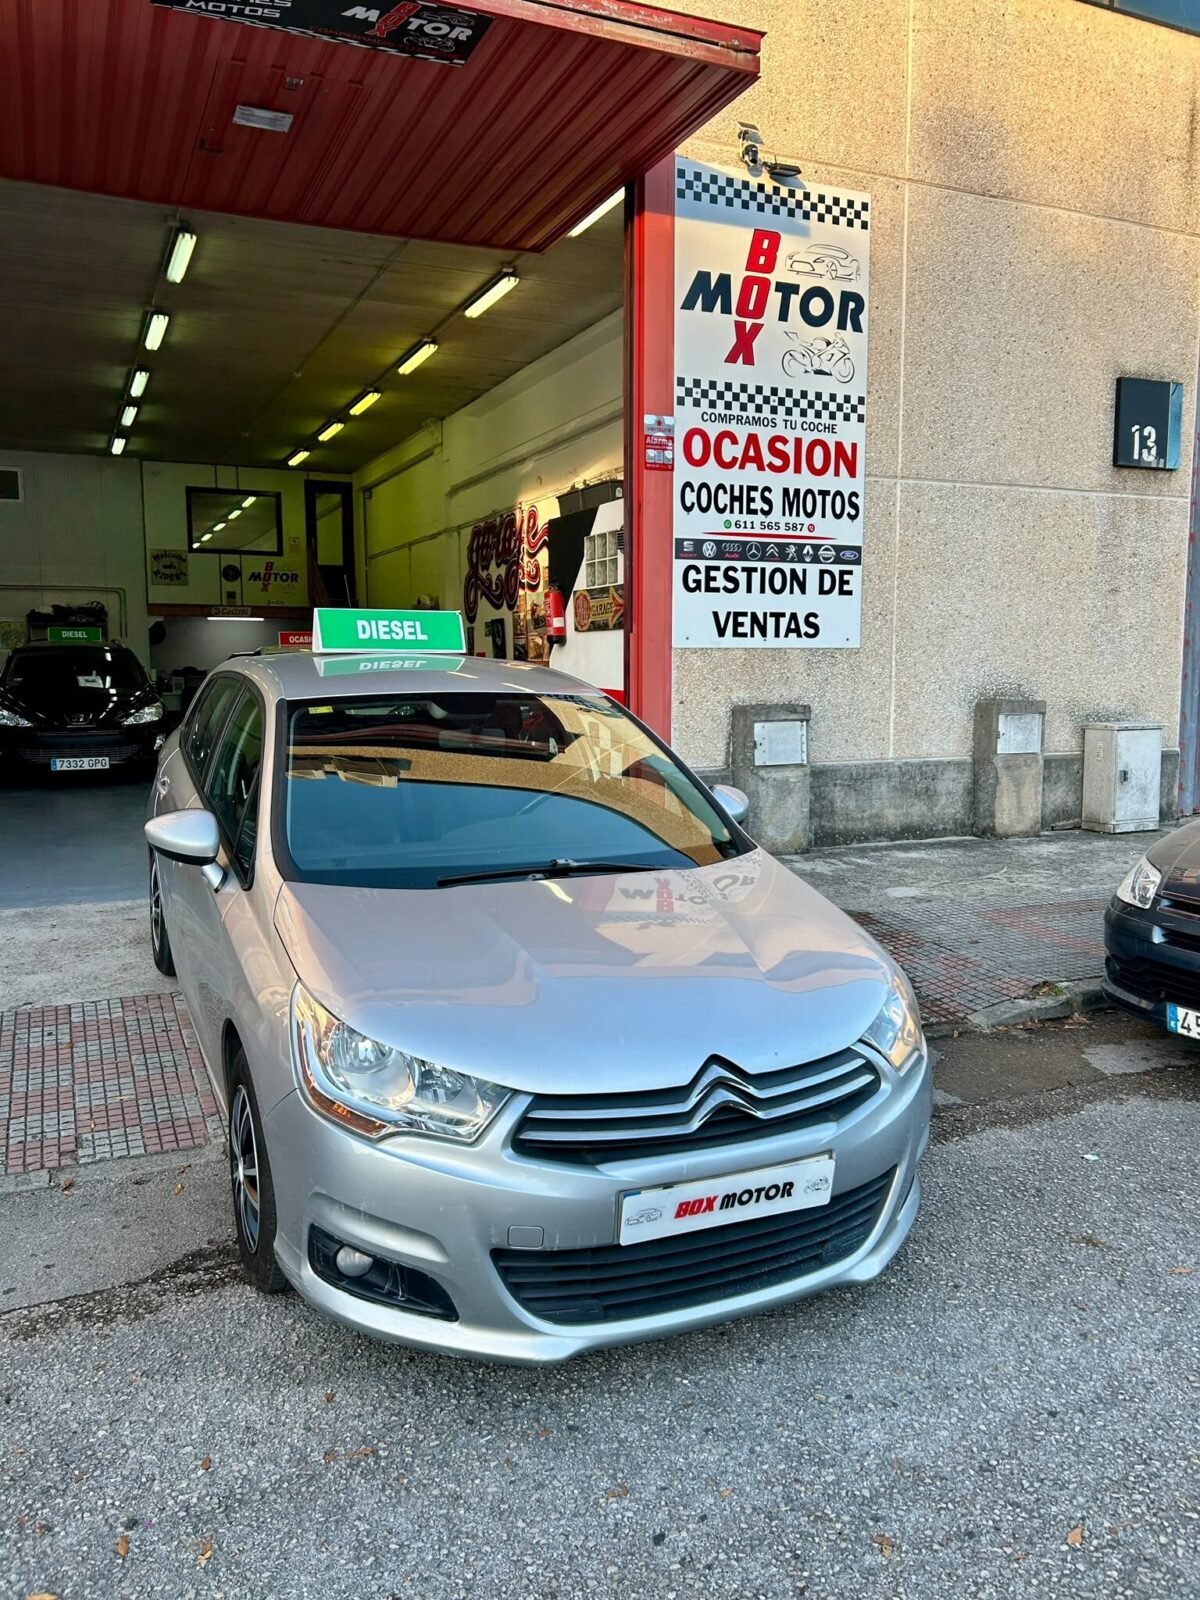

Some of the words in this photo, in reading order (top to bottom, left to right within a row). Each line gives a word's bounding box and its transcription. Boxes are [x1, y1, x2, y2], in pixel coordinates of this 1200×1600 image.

[185, 0, 281, 18] MOTOS
[340, 5, 473, 41] MOTOR
[364, 1, 422, 38] BOX
[680, 270, 866, 333] MOTOR
[724, 228, 782, 366] BOX
[701, 411, 777, 428] COMPRAMOS
[782, 418, 798, 431] TU
[800, 421, 838, 434] COCHE
[646, 436, 673, 446] Alarma
[683, 428, 858, 478] OCASION
[1131, 424, 1157, 462] 13
[680, 481, 773, 517] COCHES
[782, 487, 860, 521] MOTOS
[734, 520, 756, 530] 611
[759, 521, 781, 531] 565
[784, 523, 805, 532] 587
[248, 571, 298, 583] MOTOR
[682, 564, 807, 595] GESTION
[818, 569, 853, 596] DE
[289, 635, 313, 644] OCASI
[356, 620, 428, 641] DIESEL
[712, 611, 820, 639] VENTAS
[59, 759, 85, 769] 7332
[88, 758, 108, 768] GPG
[674, 1195, 719, 1219] BOX
[719, 1182, 794, 1210] MOTOR
